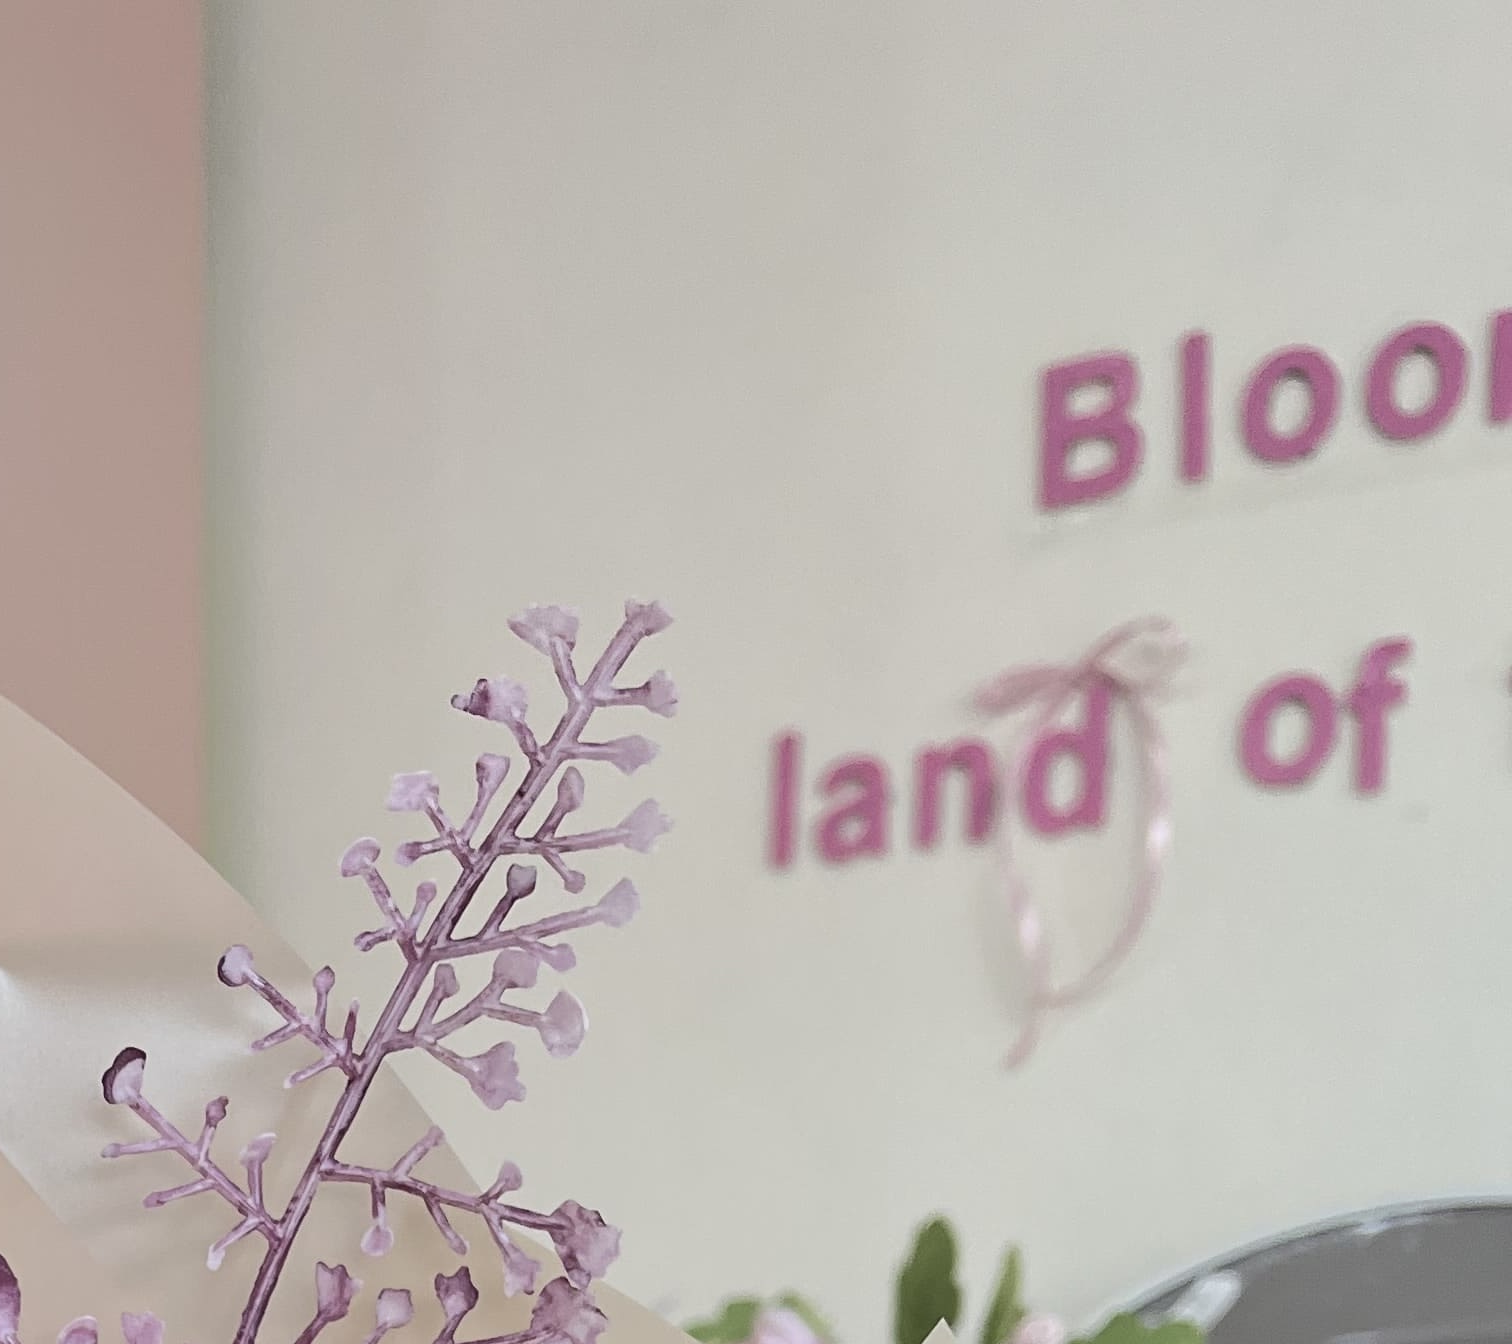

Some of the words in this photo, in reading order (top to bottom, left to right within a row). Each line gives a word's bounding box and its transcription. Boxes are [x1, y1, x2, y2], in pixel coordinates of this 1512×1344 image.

[1038, 309, 1512, 512] Bloo
[768, 674, 1114, 872] land
[1238, 635, 1414, 797] of
